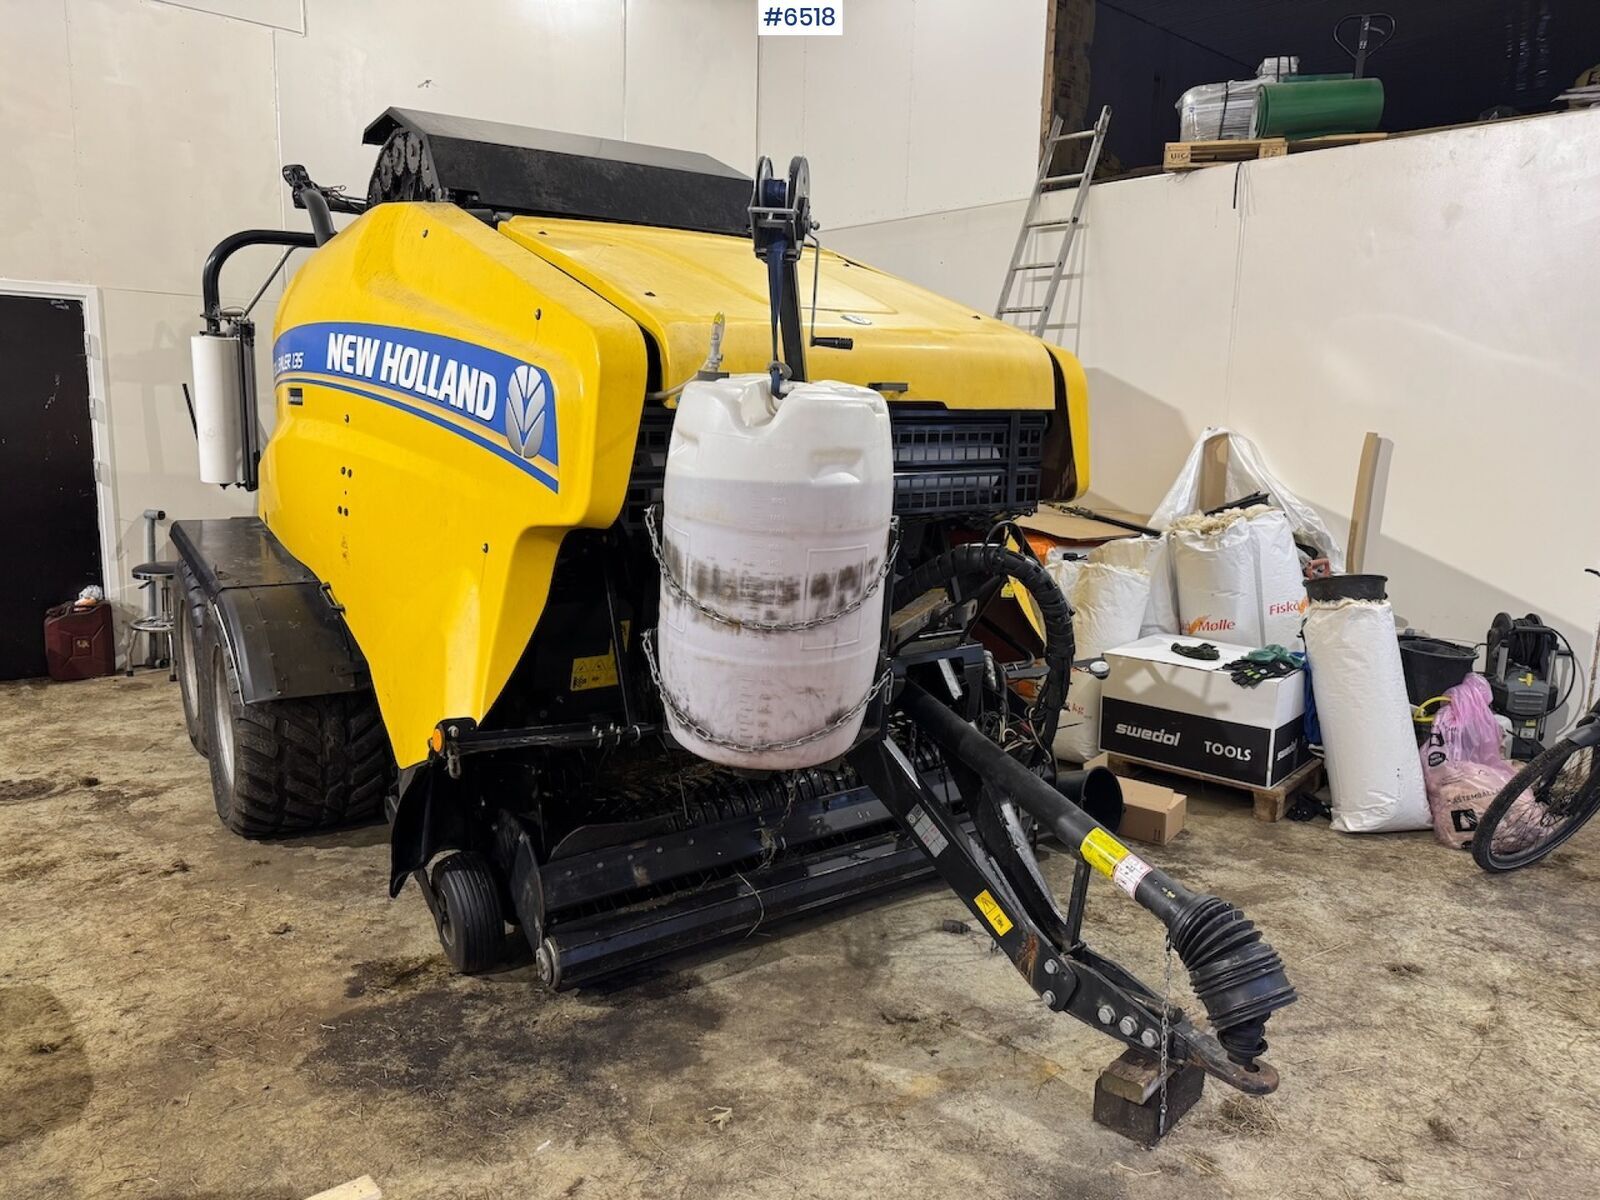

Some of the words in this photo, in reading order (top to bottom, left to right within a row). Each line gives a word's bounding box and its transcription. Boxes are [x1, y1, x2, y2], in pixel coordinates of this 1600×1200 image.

[326, 332, 381, 378] NEW
[379, 343, 497, 421] HOLLAND
[1198, 619, 1236, 632] Mølle
[1115, 723, 1181, 747] swedol
[1204, 741, 1251, 761] TOOLS
